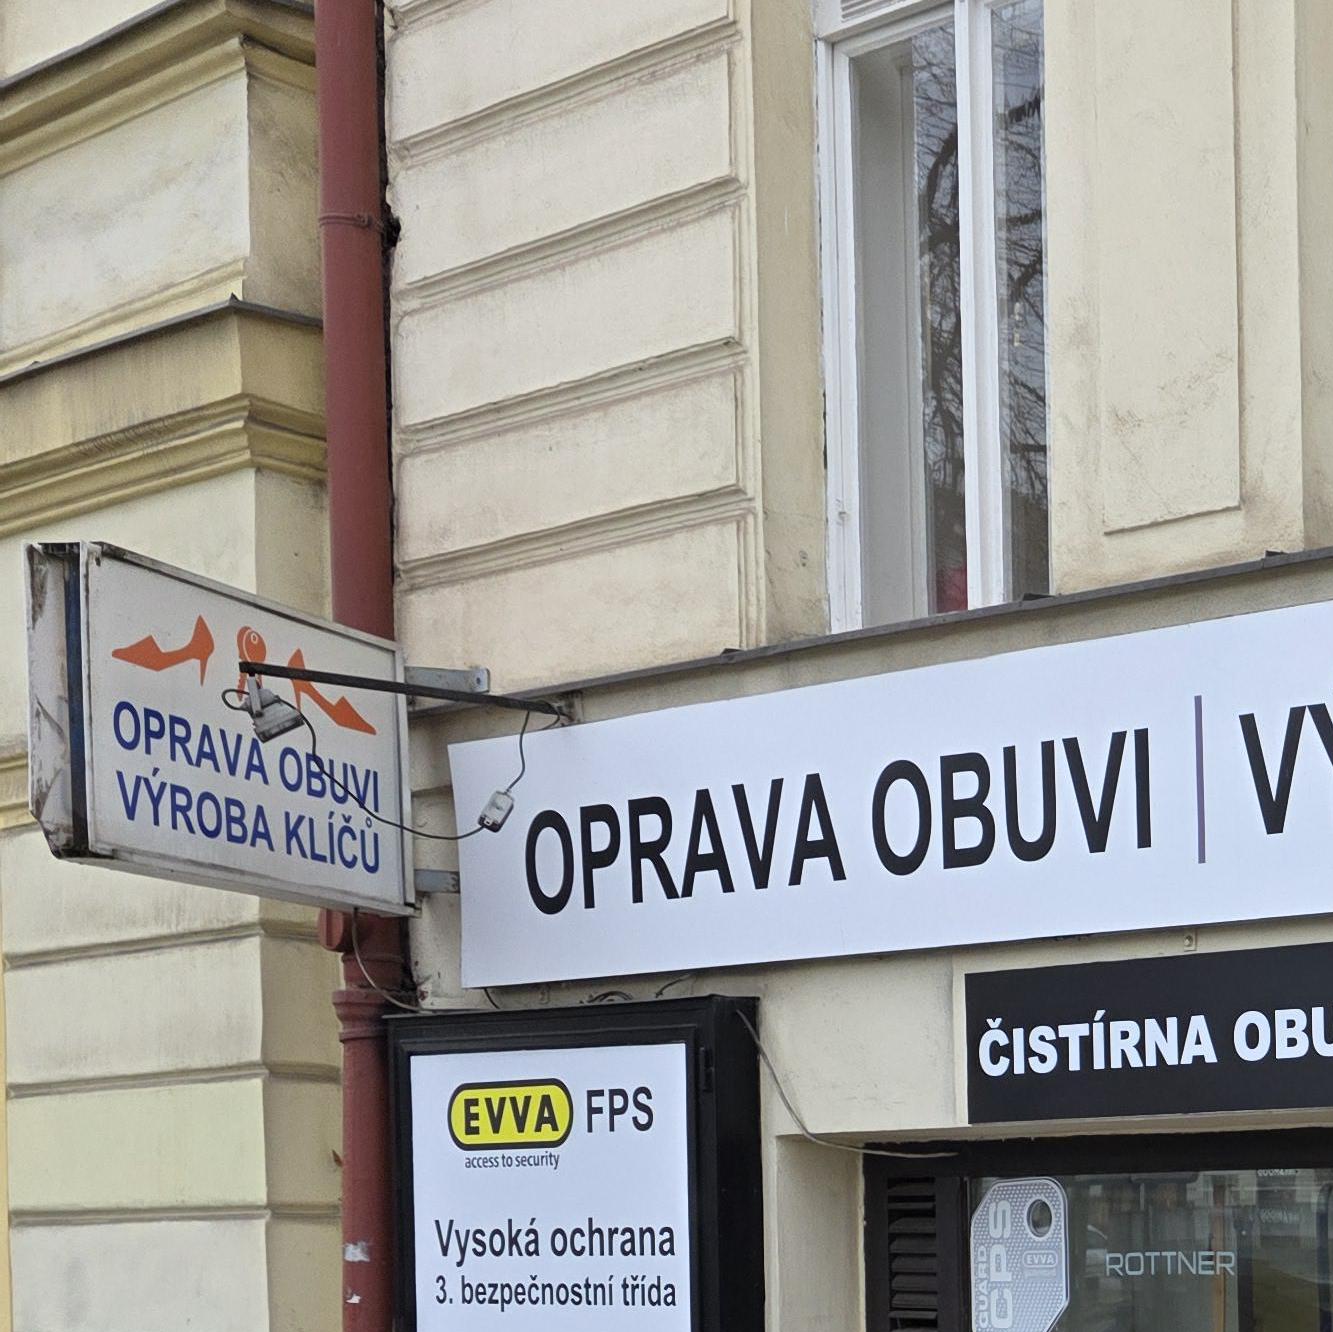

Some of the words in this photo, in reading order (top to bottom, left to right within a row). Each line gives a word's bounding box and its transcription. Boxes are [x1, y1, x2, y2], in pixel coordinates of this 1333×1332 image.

[113, 700, 270, 786] OPRAVA
[279, 746, 379, 814] OBUVI
[116, 767, 275, 852] VÝROBA
[284, 811, 380, 874] KLÍČŮ
[526, 771, 848, 916] OPRAVA
[872, 728, 1151, 875] OBUVI
[979, 1010, 1217, 1076] ČISTÍRNA
[464, 1095, 559, 1135] EVVA
[587, 1087, 653, 1133] FPS
[465, 1157, 499, 1168] access
[502, 1154, 512, 1167] to
[515, 1153, 559, 1169] security
[435, 1218, 539, 1267] Vysoká
[551, 1218, 675, 1256] ochrana
[988, 1199, 1013, 1329] CPS
[1026, 1254, 1055, 1265] EVVA
[1105, 1251, 1236, 1277] ROTTNER
[436, 1275, 452, 1304] 3.
[462, 1275, 613, 1312] bezpečnostní
[621, 1275, 676, 1306] třída
[975, 1245, 989, 1328] GUARD
